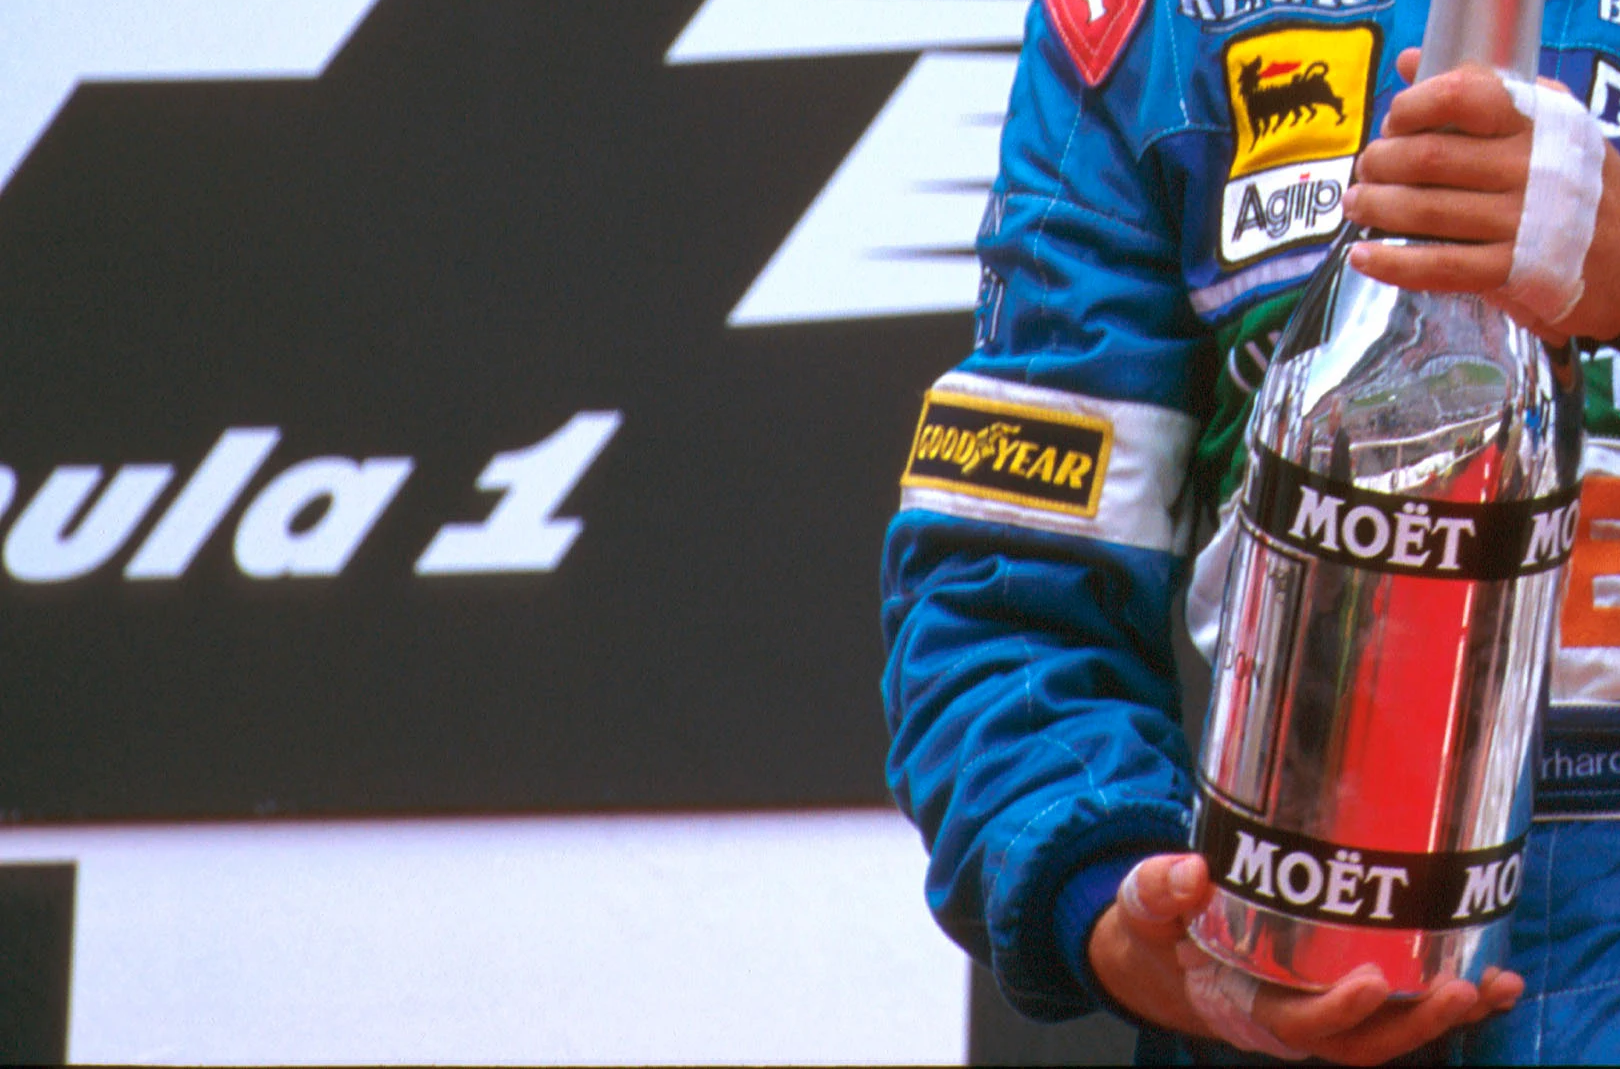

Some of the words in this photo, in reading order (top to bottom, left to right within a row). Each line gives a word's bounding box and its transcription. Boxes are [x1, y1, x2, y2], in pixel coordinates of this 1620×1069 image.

[1231, 173, 1341, 245] Agip
[0, 426, 416, 583] ula
[414, 409, 624, 576] 1
[1289, 486, 1476, 570] MOËT
[1226, 831, 1409, 920] MOËT
